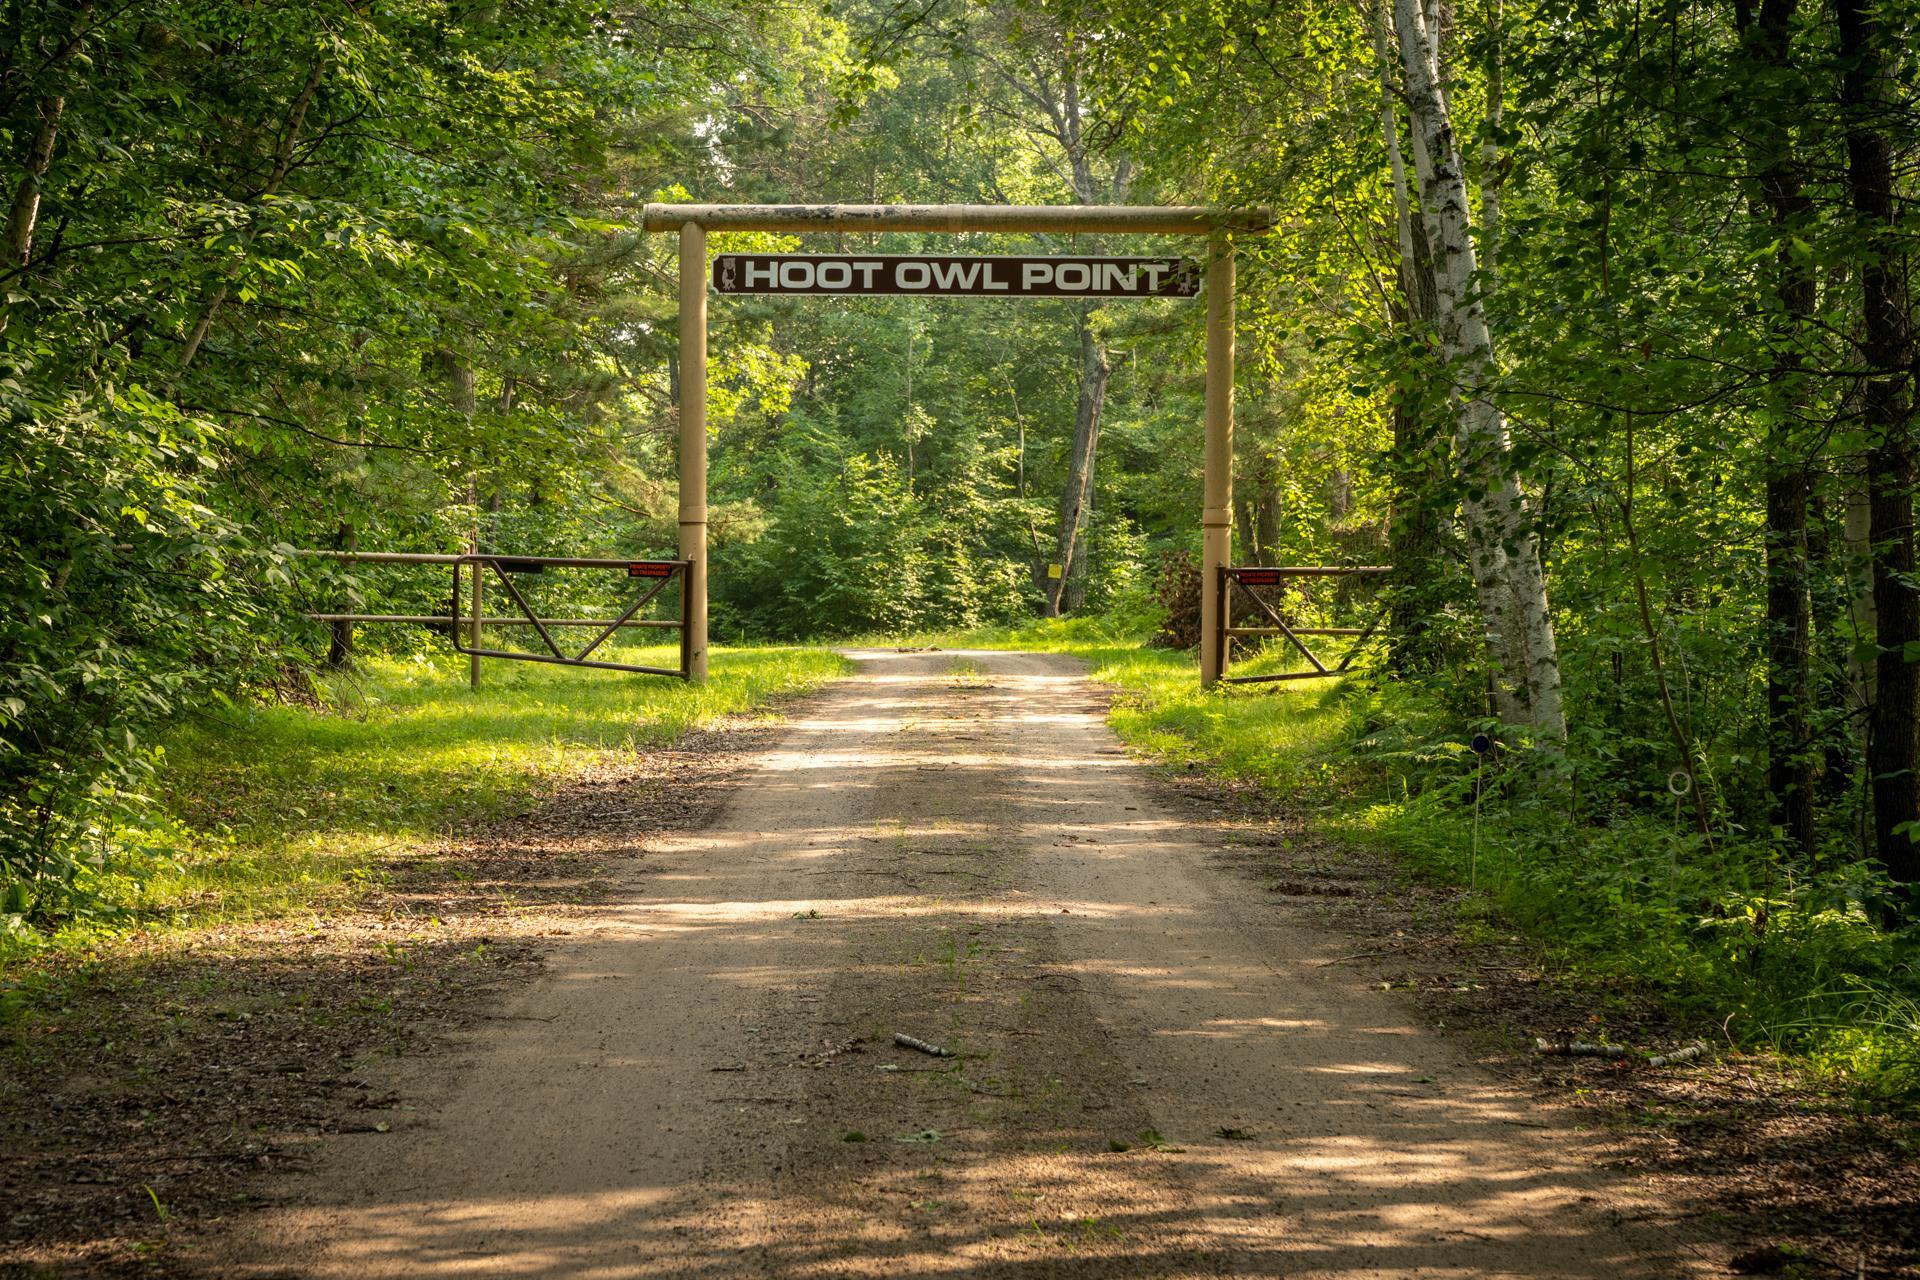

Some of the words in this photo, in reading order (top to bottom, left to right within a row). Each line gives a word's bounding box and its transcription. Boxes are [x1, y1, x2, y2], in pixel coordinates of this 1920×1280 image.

[745, 261, 884, 290] HOOT
[895, 261, 1008, 290] OWL
[1022, 263, 1171, 291] POINT
